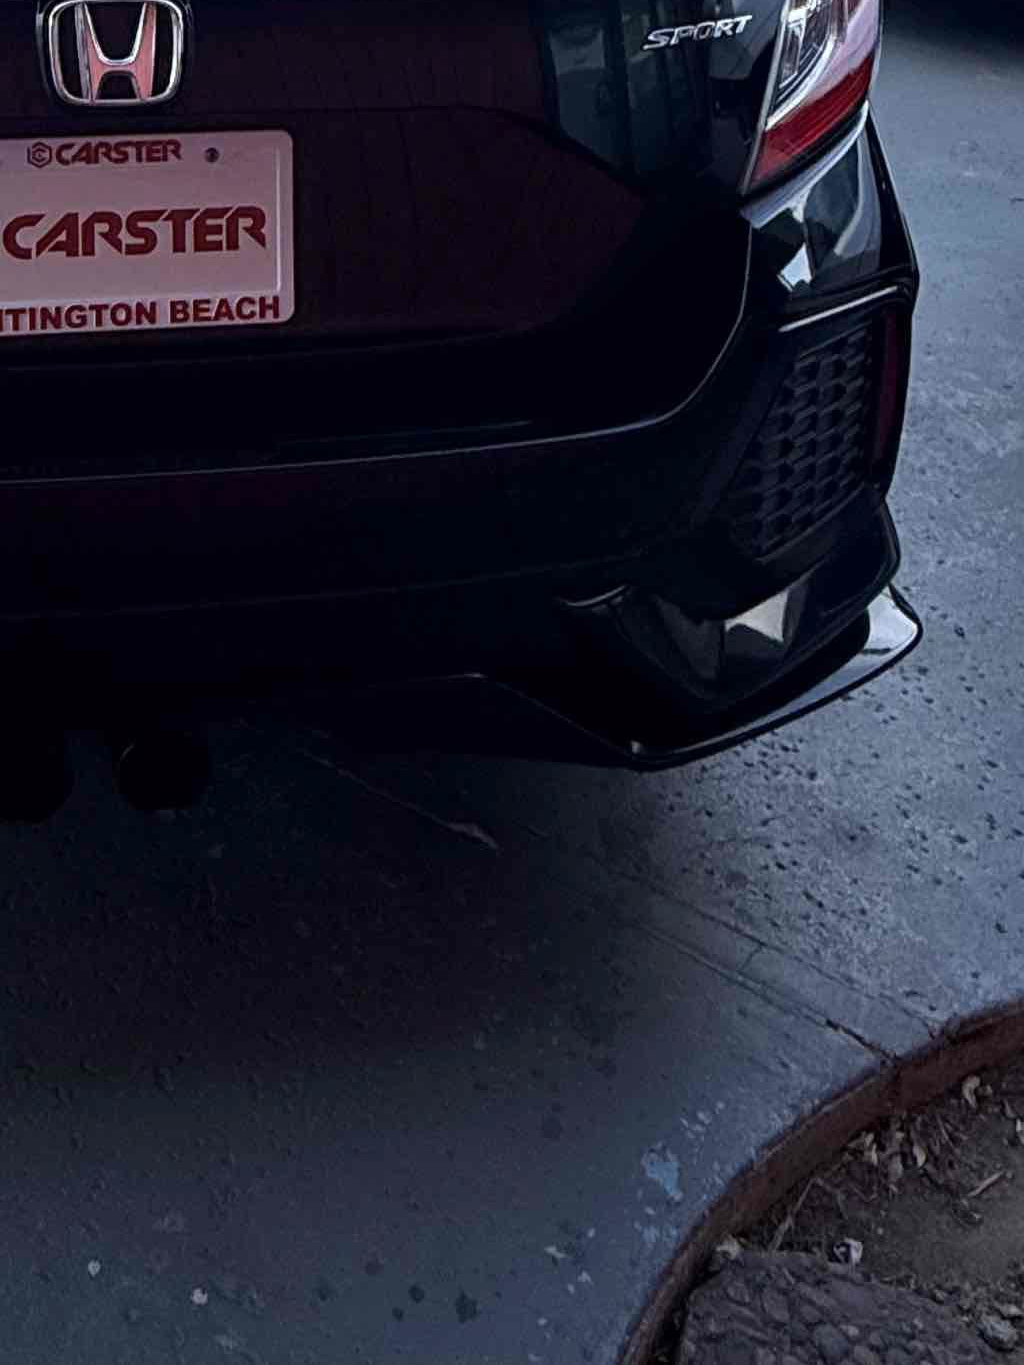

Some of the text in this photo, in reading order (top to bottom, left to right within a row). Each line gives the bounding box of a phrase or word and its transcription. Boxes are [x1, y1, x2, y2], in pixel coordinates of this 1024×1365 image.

[642, 14, 753, 50] SPORT
[56, 139, 182, 167] CARSTER
[2, 205, 267, 260] CARSTER
[169, 295, 280, 324] BEACH
